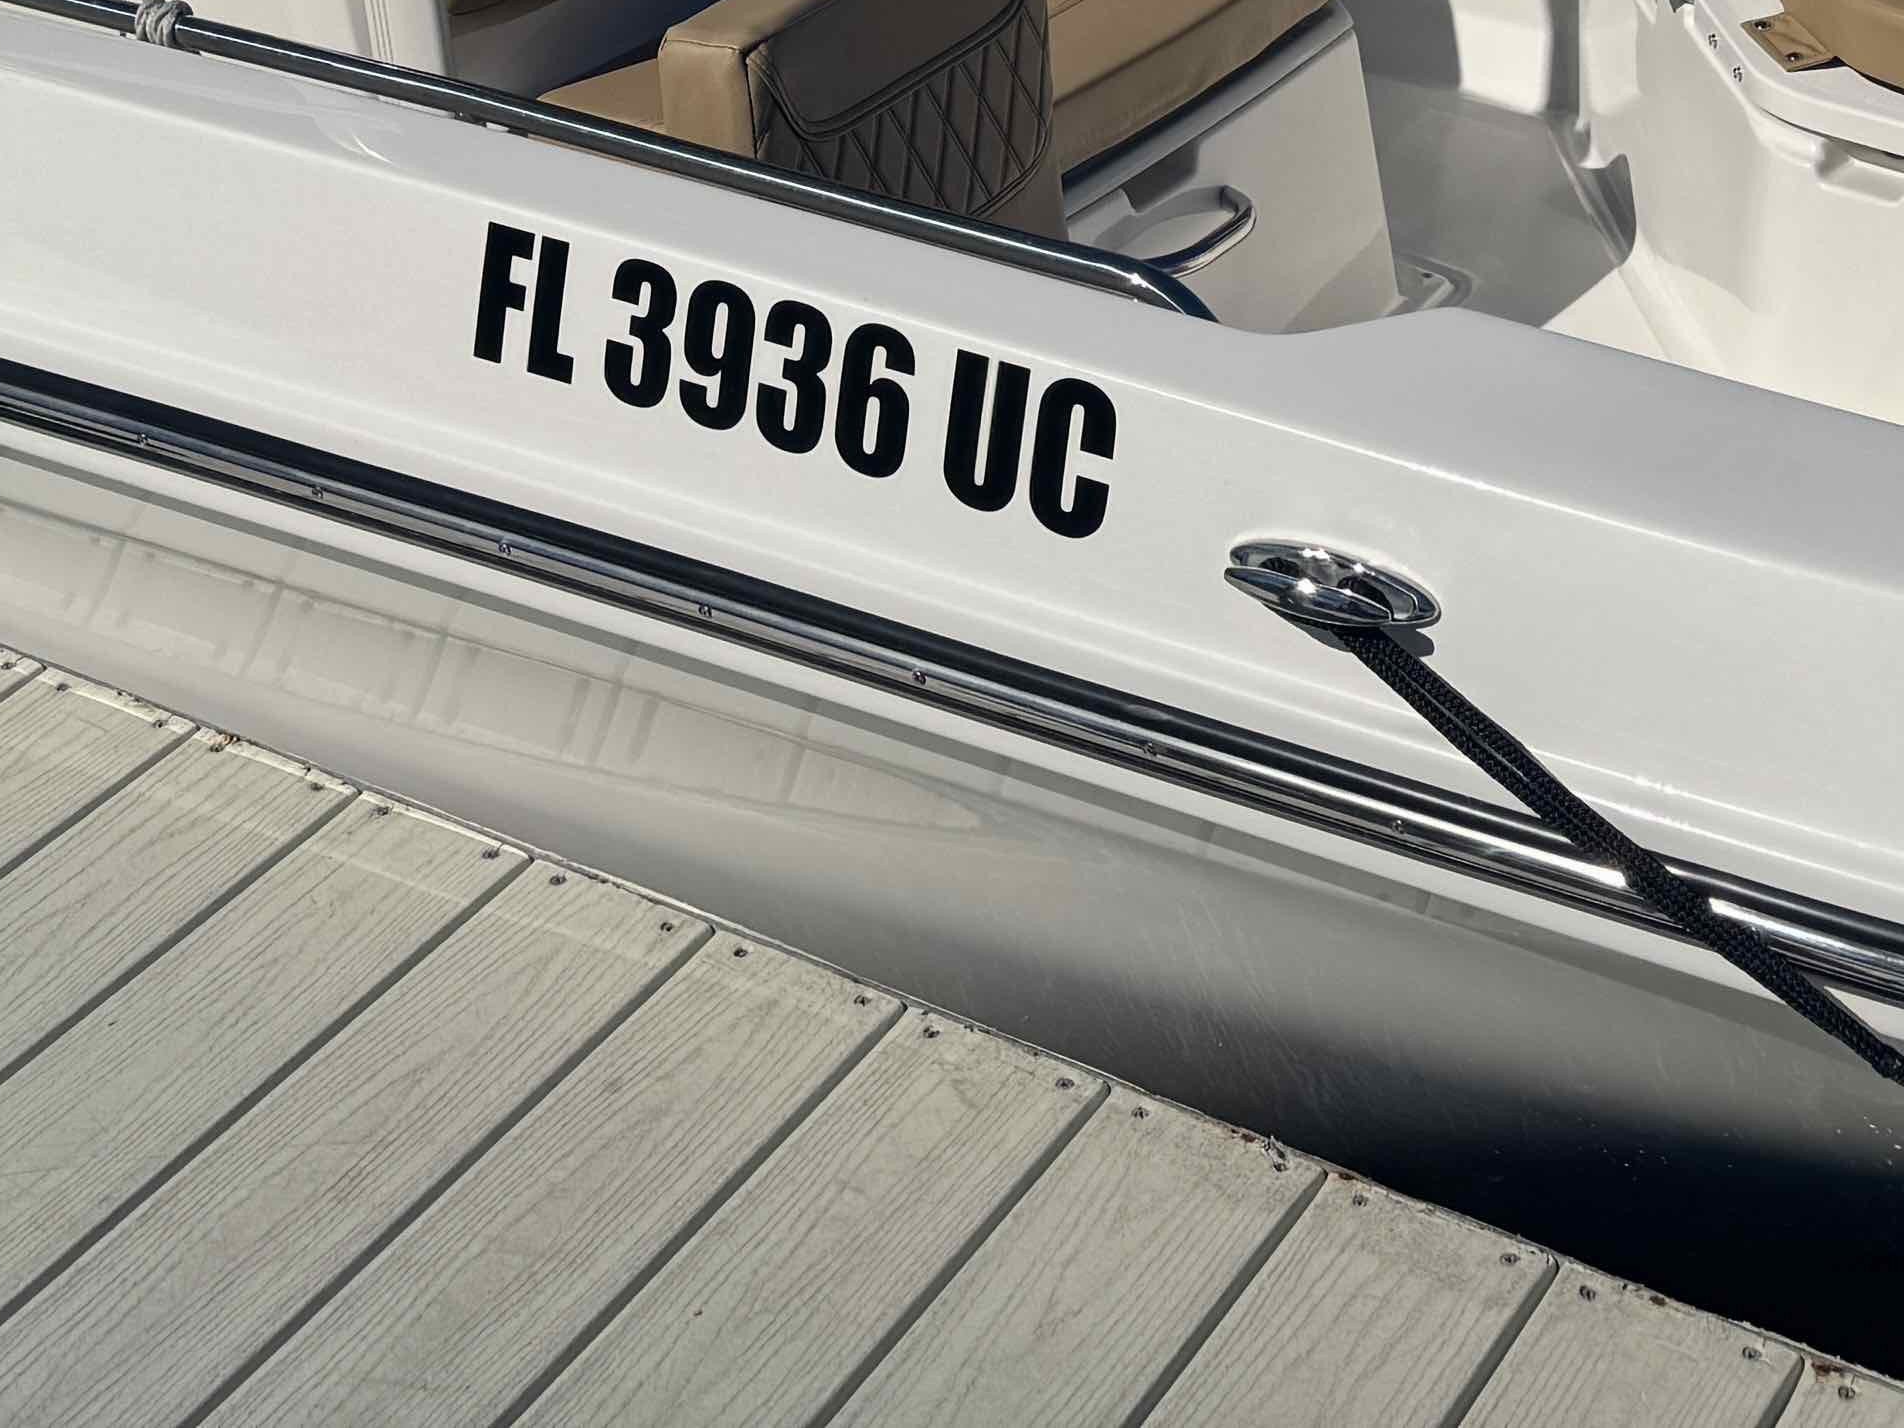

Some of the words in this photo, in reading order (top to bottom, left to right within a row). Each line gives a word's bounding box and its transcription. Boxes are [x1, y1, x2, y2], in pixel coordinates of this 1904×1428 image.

[473, 221, 575, 385] FL
[603, 257, 917, 479] 3936
[943, 348, 1117, 539] UC
